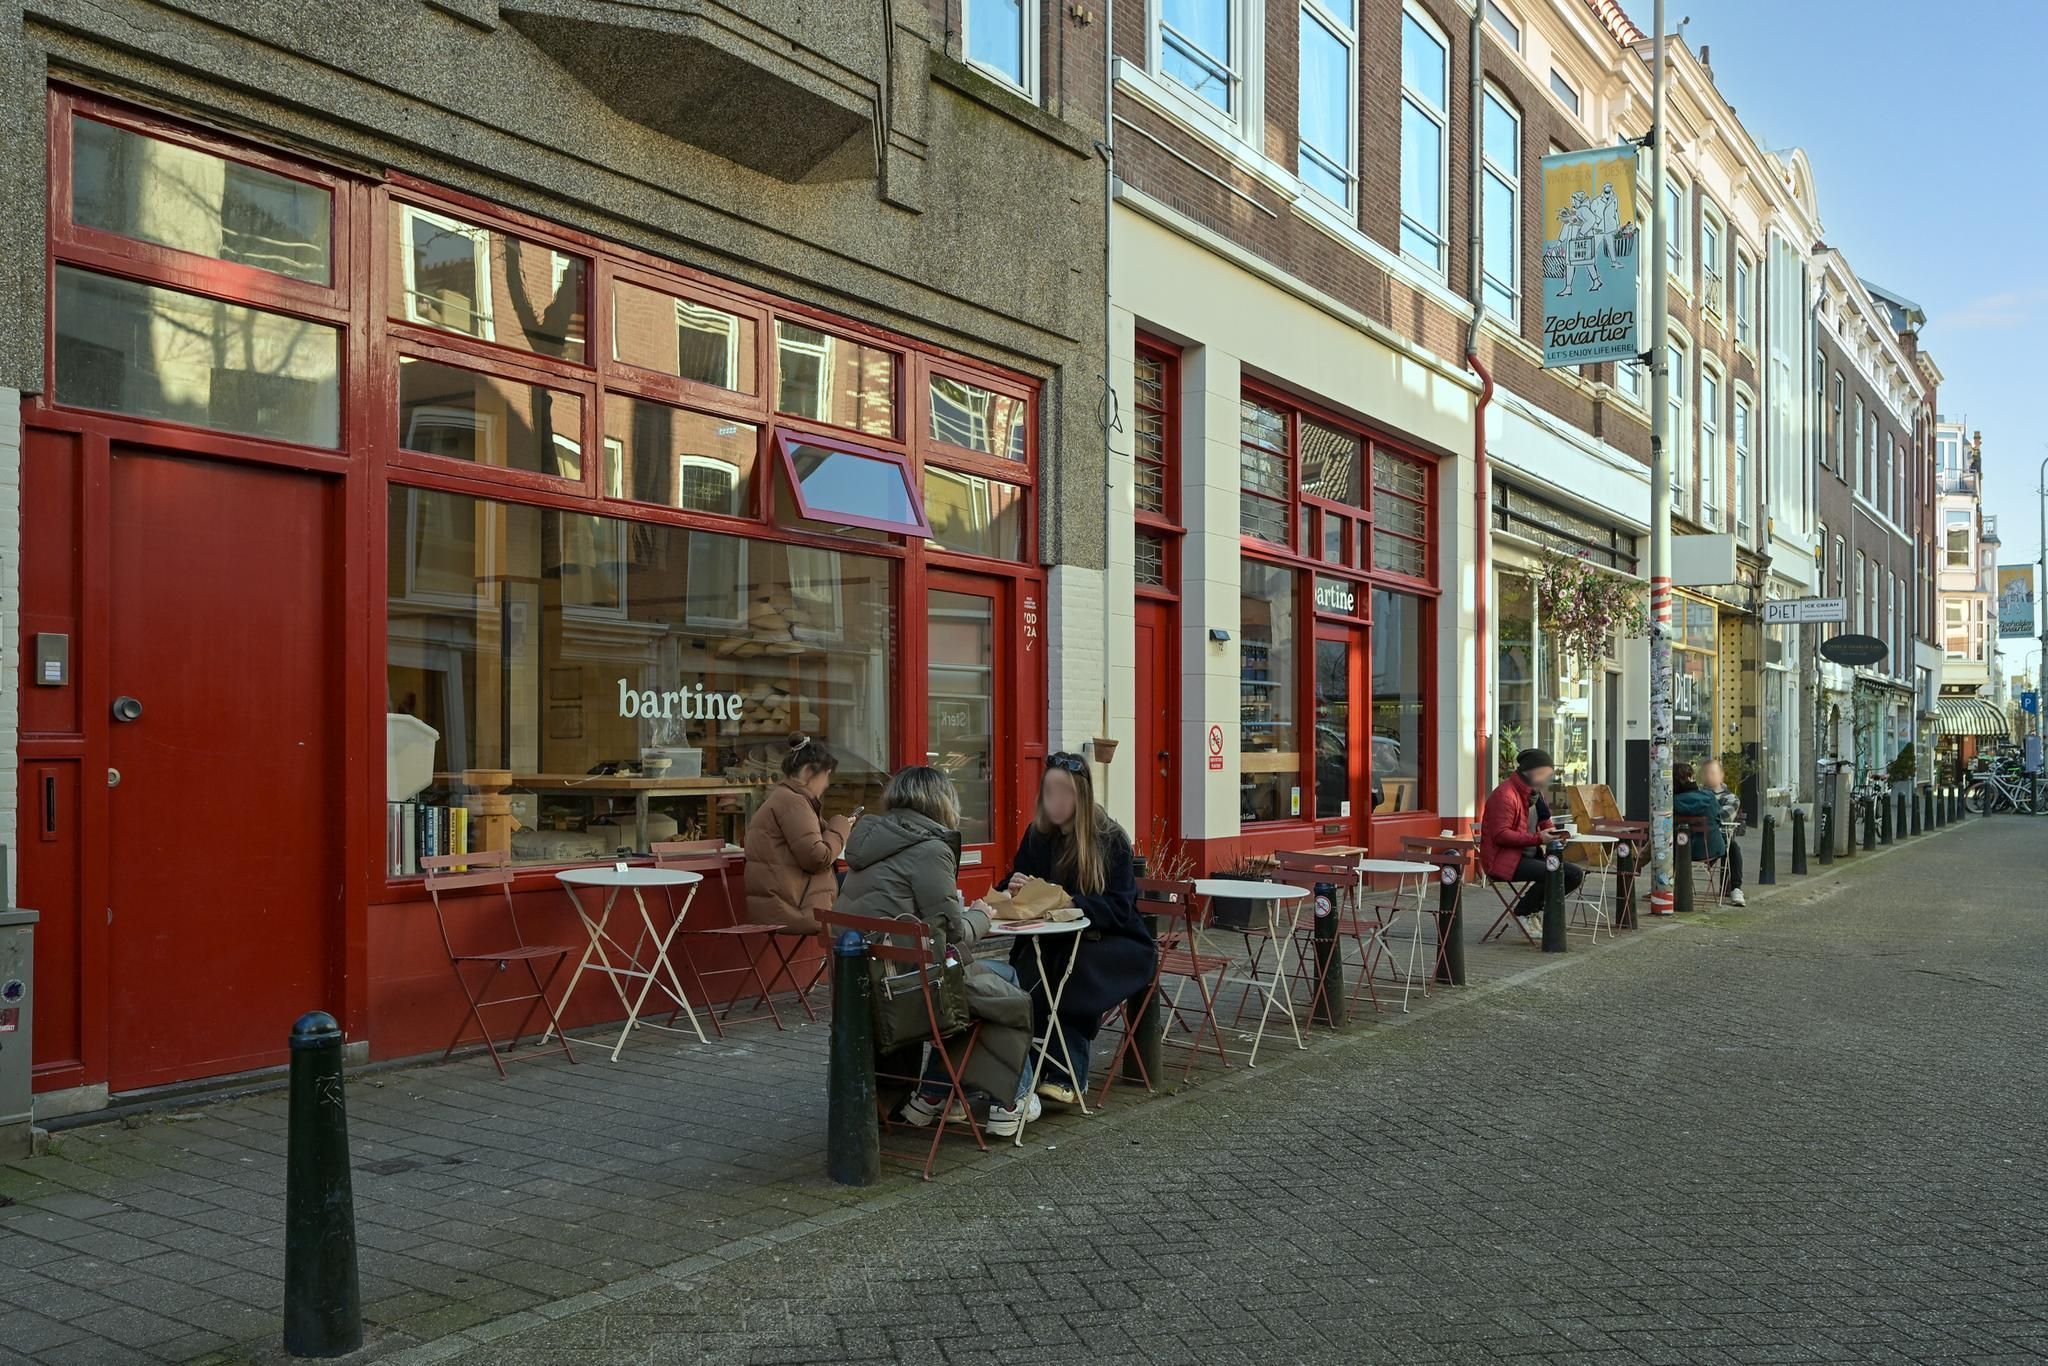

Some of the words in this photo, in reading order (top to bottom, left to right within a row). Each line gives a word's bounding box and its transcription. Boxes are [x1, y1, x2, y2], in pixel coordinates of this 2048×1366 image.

[1574, 241, 1587, 250] TAKE
[1544, 307, 1634, 334] Zeehelden
[1549, 325, 1633, 348] kwartier
[1547, 350, 1568, 360] LET'S
[1568, 348, 1593, 358] ENJOY
[1593, 346, 1611, 355] LIFE
[1611, 343, 1634, 353] HERE!
[1315, 584, 1354, 611] artine
[617, 678, 743, 721] bartine
[2024, 698, 2031, 708] P
